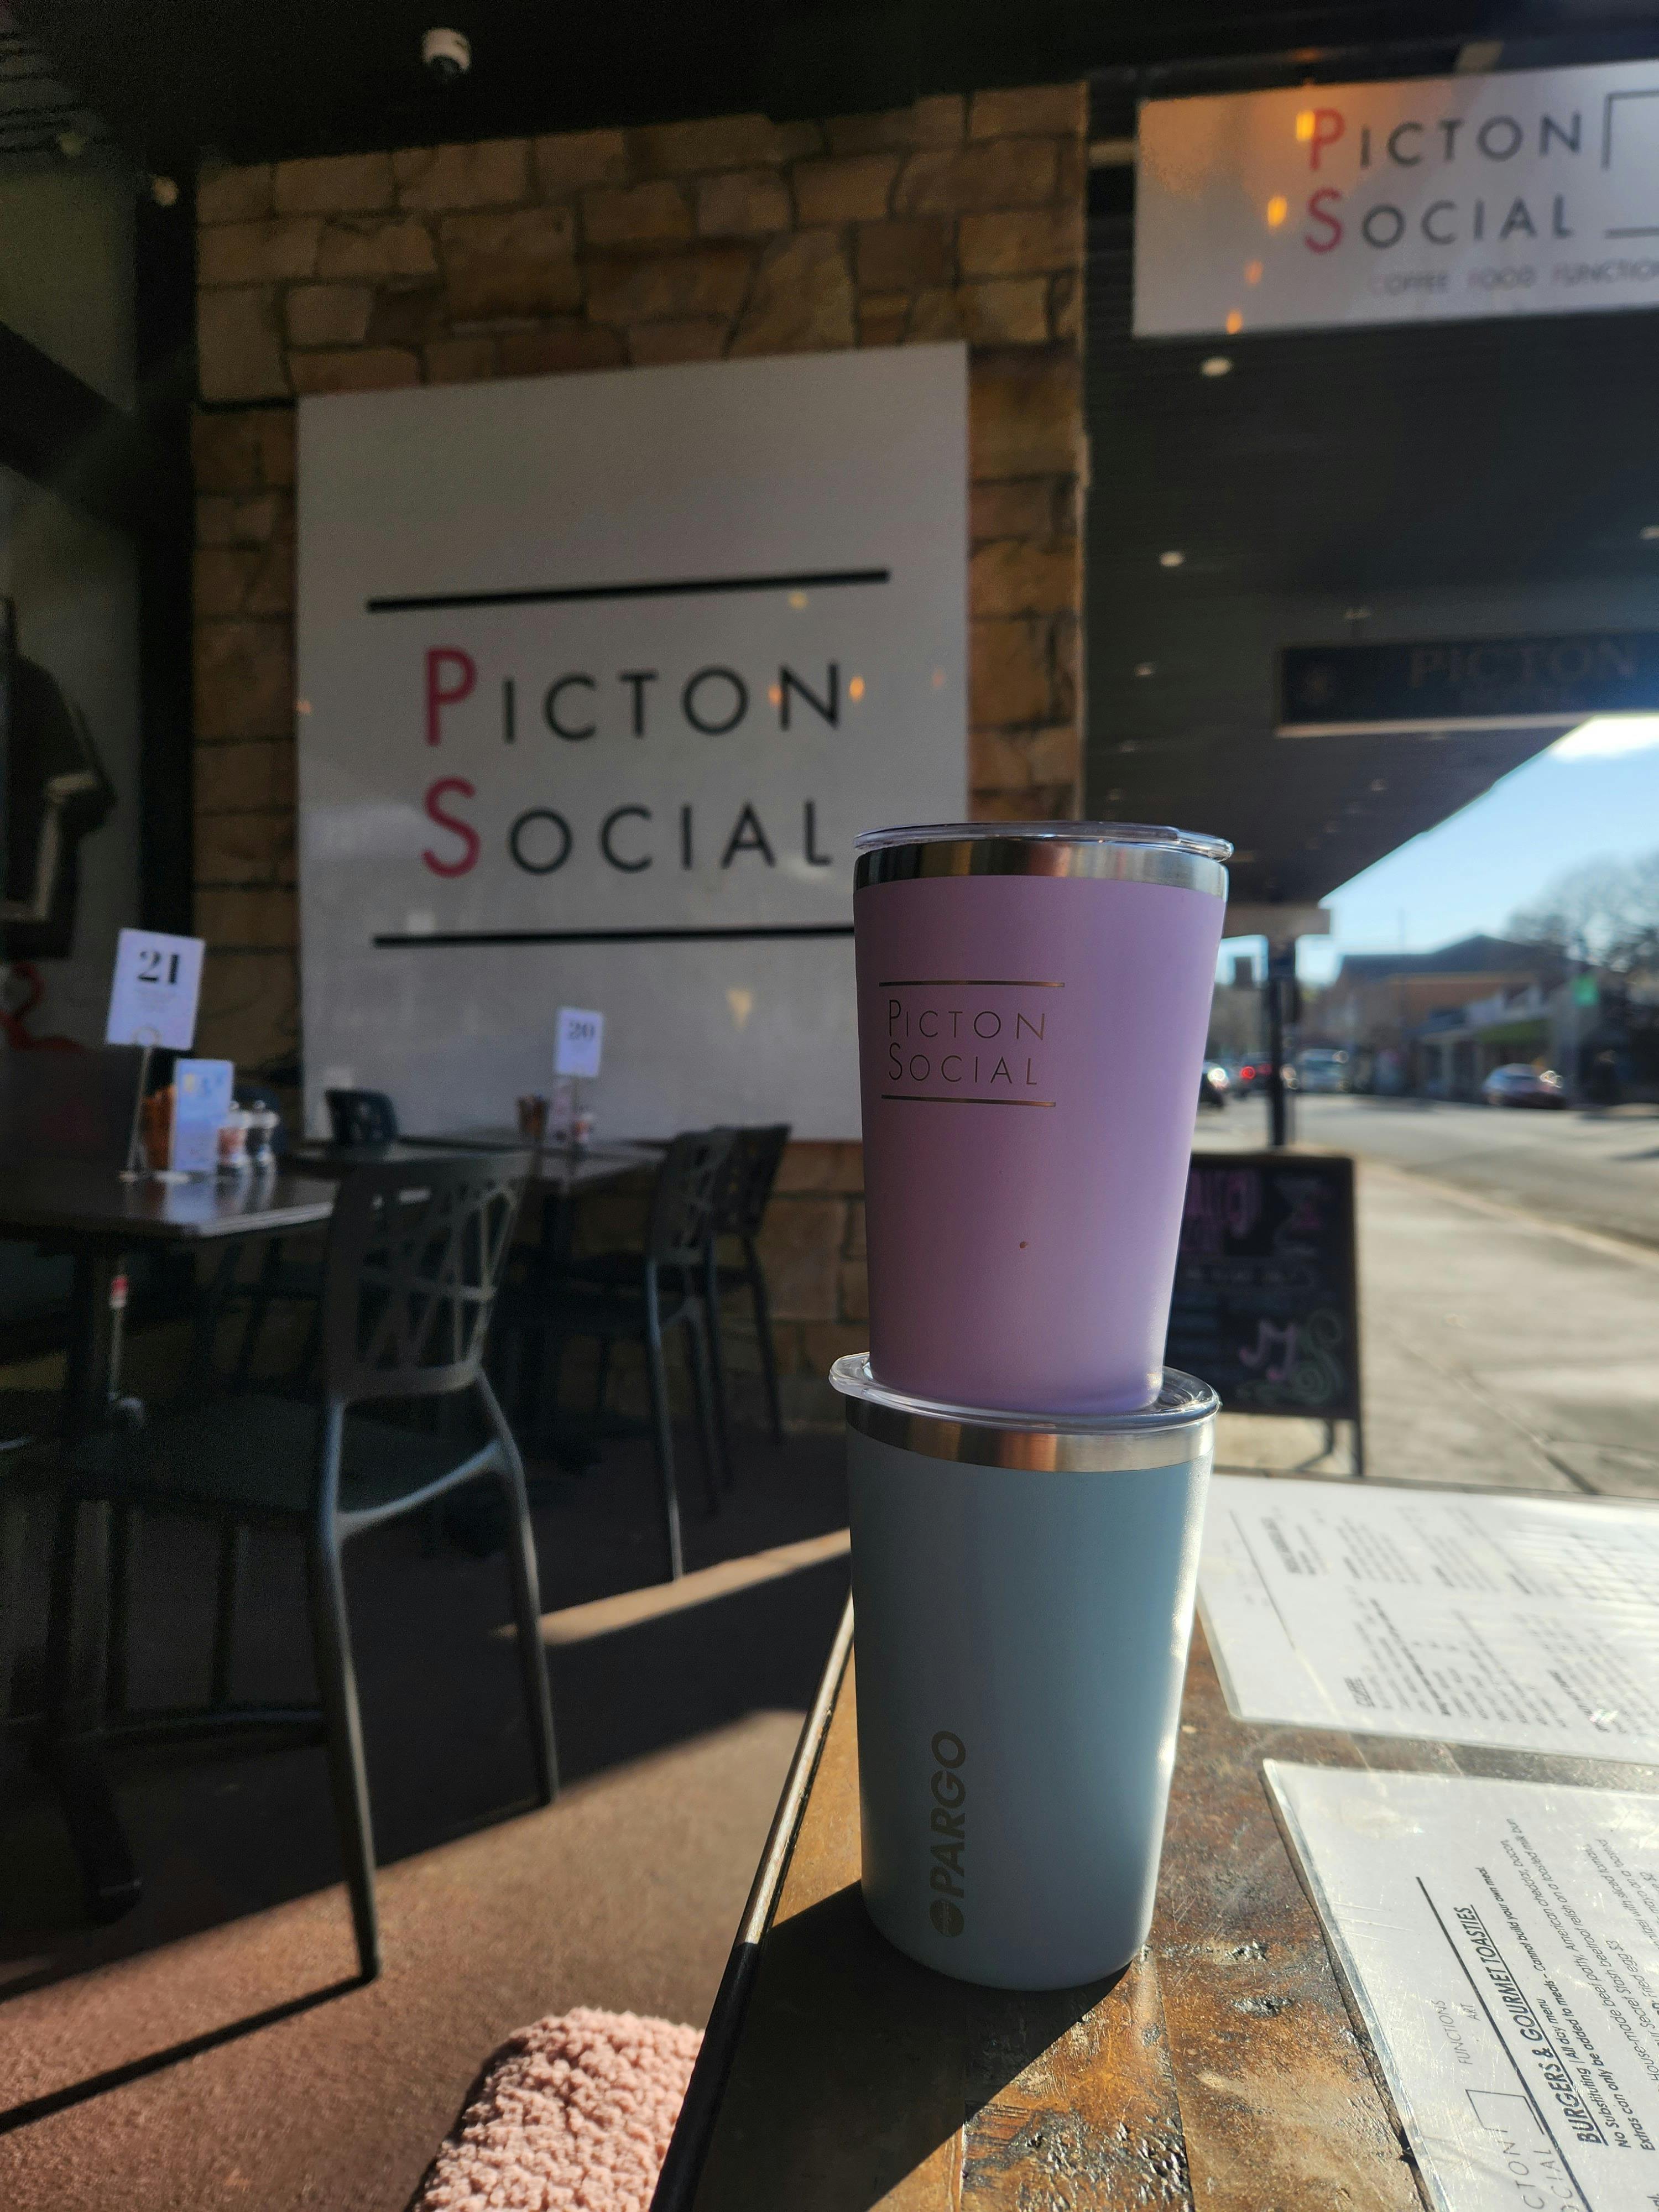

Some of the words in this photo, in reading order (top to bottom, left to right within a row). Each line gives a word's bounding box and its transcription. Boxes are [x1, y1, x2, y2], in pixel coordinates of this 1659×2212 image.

[1310, 107, 1582, 171] PICTON
[1305, 187, 1574, 253] SOCIAL
[424, 646, 839, 746] PICTON
[421, 775, 833, 878] SOCIAL
[137, 950, 181, 984] 21
[888, 999, 1045, 1041] PICTON
[888, 1042, 1037, 1085] SOCIAL
[930, 1730, 967, 1899] PARGO
[1525, 1851, 1553, 1881] toasted
[1639, 1872, 1657, 1882] $2
[1489, 1887, 1504, 1902] own
[1518, 1869, 1549, 1907] cheddar,
[1600, 1875, 1628, 1898] sliced
[1626, 1879, 1641, 1889] on
[1553, 1892, 1568, 1903] on
[1621, 1900, 1641, 1917] with
[1637, 1891, 1659, 1914] mayo
[1499, 1903, 1518, 1920] your
[1561, 1905, 1583, 1926] relish
[1453, 1907, 1501, 1963] TOASTIES
[1507, 1921, 1528, 1941] build
[1543, 1908, 1579, 1952] American
[1519, 1942, 1546, 1971] Cannot
[1574, 1928, 1612, 1967] beetroot
[1605, 1940, 1624, 1952] $3
[1573, 1954, 1602, 1981] patty,
[1617, 1953, 1639, 1973] egg
[1543, 1980, 1568, 2006] meals
[1588, 1983, 1616, 2007] beef
[1605, 1969, 1632, 1995] Stash
[1629, 1974, 1657, 1998] Fried
[1459, 2003, 1481, 2021] ART
[1485, 1966, 1543, 2041] GOURMET
[1536, 1999, 1558, 2024] menu
[1562, 2008, 1574, 2017] to
[1621, 1996, 1656, 2029] Secret
[1431, 2000, 1473, 2065] FUNCTIONS
[1552, 2026, 1570, 2044] day
[1565, 2018, 1594, 2051] added
[1610, 2009, 1659, 2081] House-made
[1531, 2048, 1554, 2058] &
[1561, 2046, 1580, 2059] All
[1589, 2053, 1605, 2066] be
[1598, 2068, 1619, 2091] only
[1538, 2063, 1602, 2143] BURGERS
[1575, 2067, 1620, 2128] Substituting
[1613, 2094, 1634, 2115] can
[1614, 2131, 1631, 2148] No
[1627, 2117, 1656, 2151] Extras
[1497, 2140, 1545, 2210] CTON
